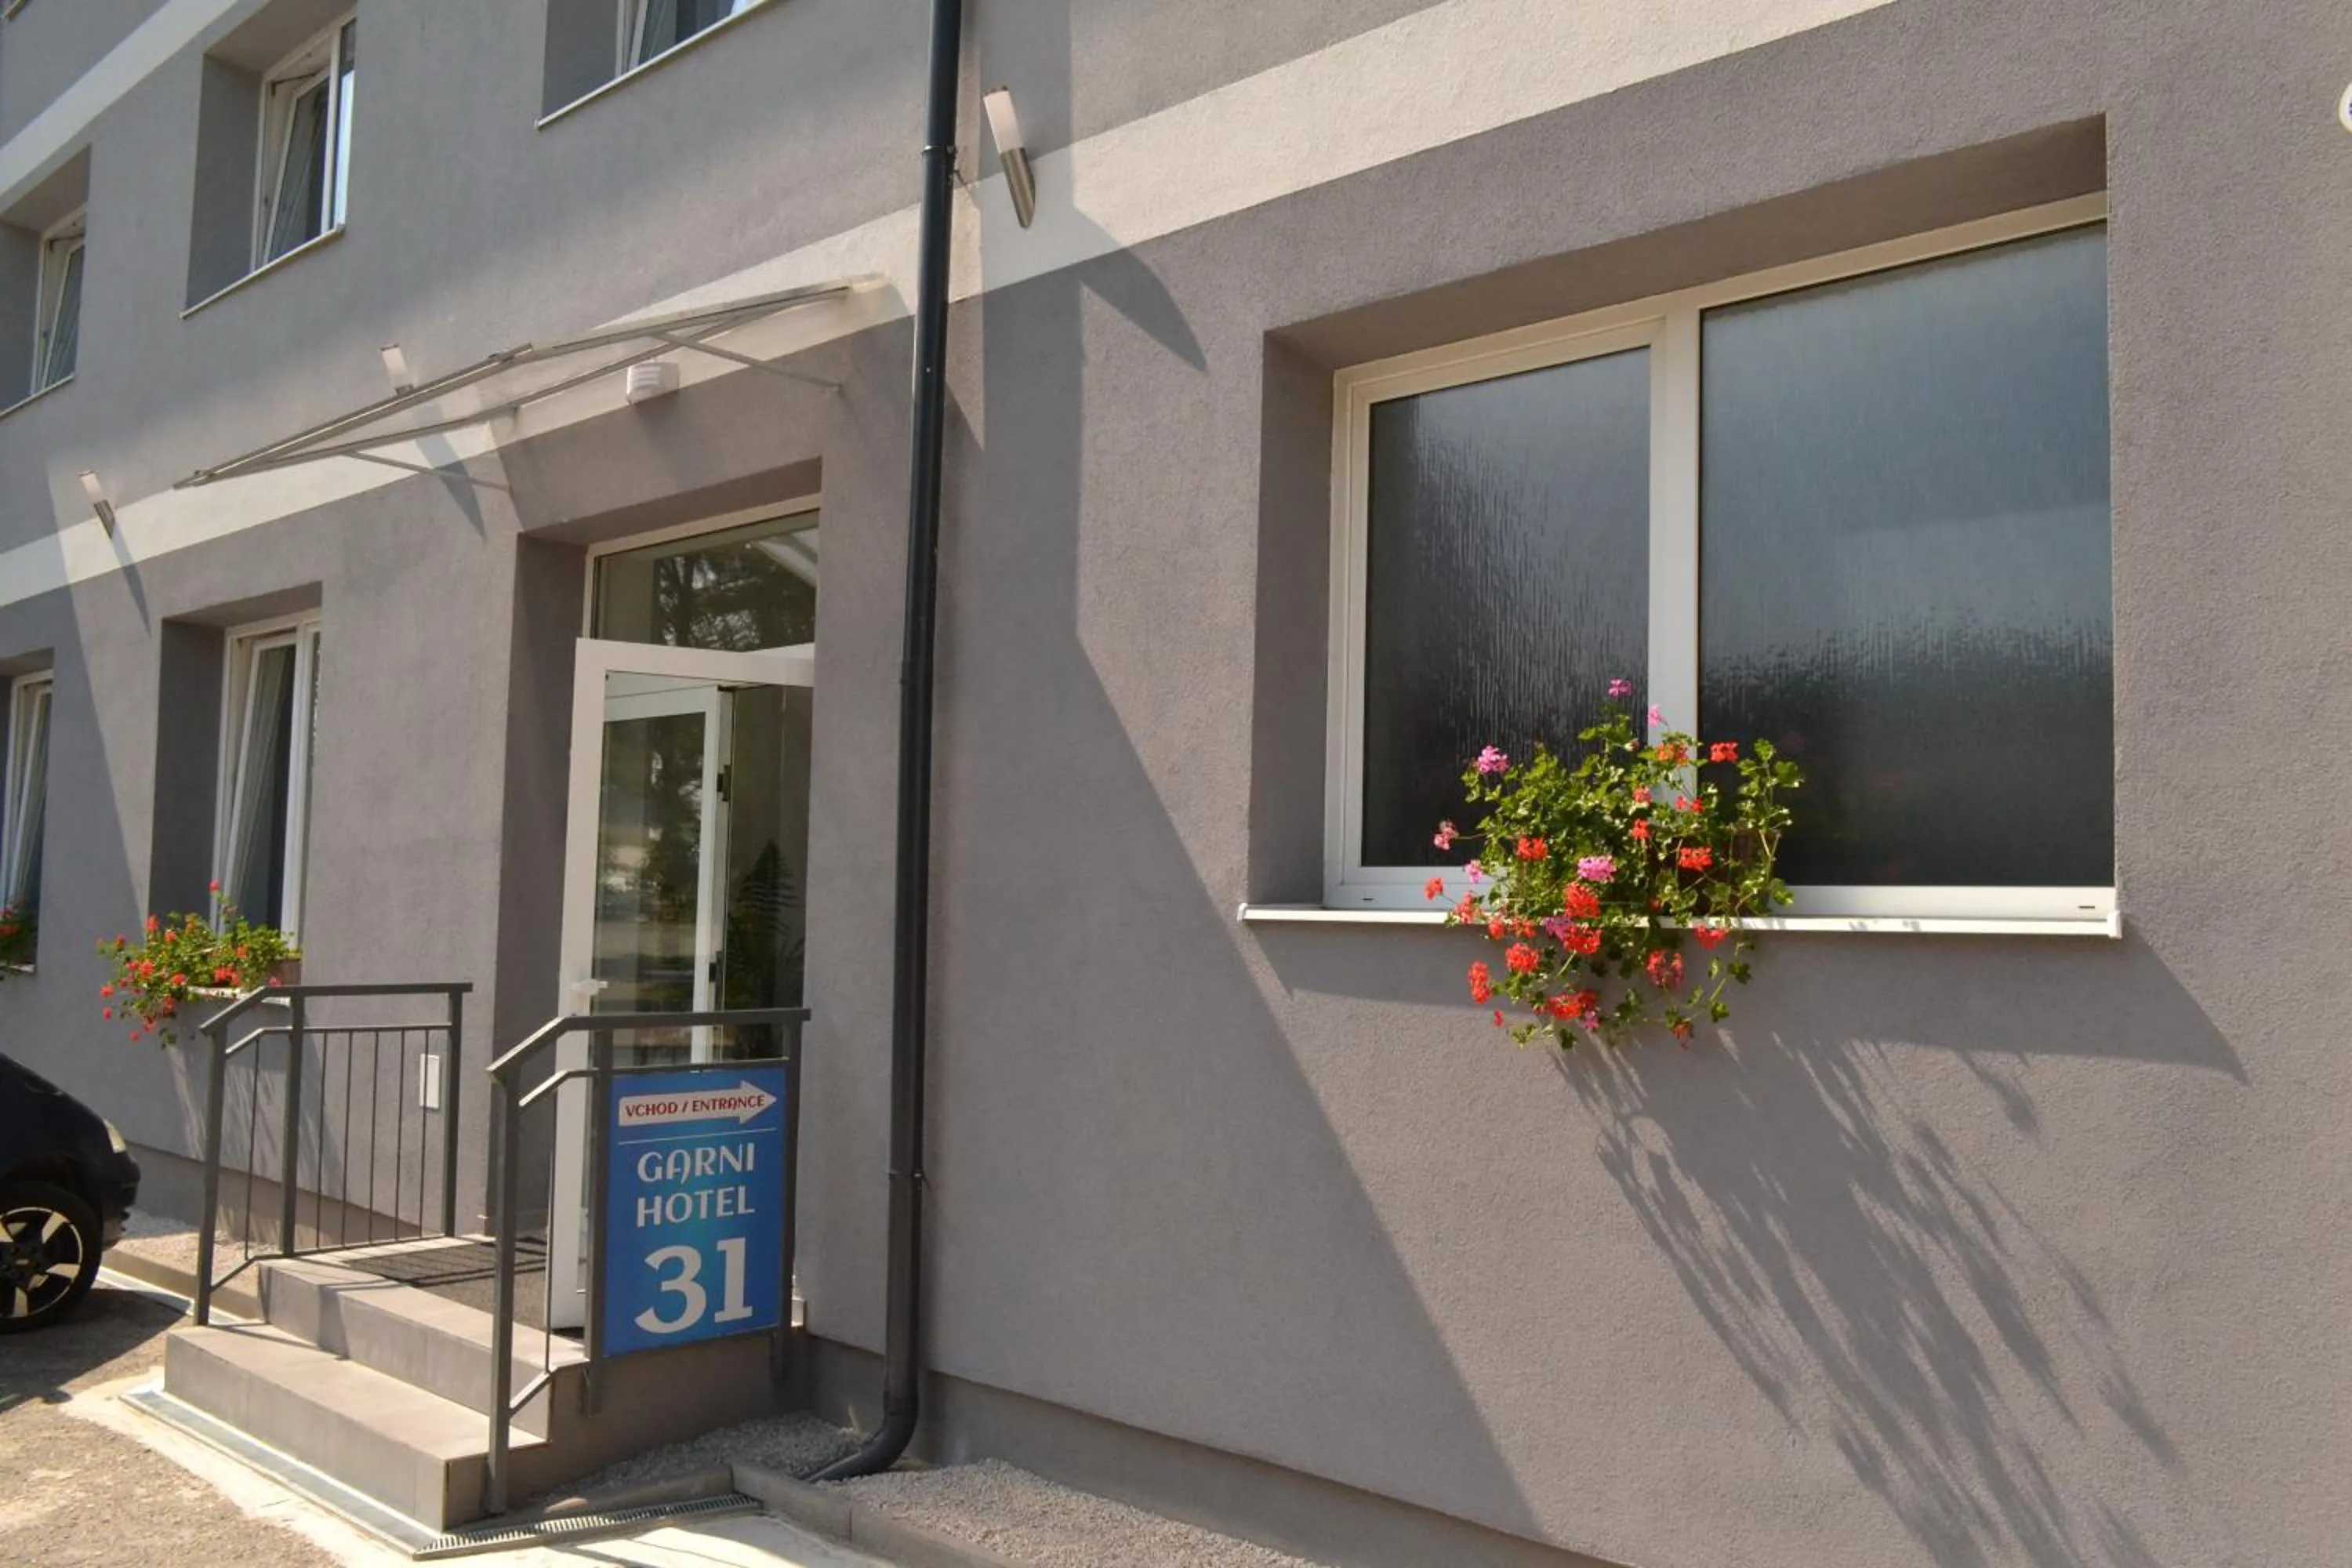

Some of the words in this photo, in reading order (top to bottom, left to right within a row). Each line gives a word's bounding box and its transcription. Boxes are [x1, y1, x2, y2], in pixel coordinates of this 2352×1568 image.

[625, 1102, 678, 1117] VCHOD
[681, 1100, 689, 1113] /
[692, 1094, 766, 1112] ENTRANCE
[637, 1143, 755, 1185] GARNI
[637, 1185, 755, 1228] HOTEL
[634, 1236, 753, 1334] 31
